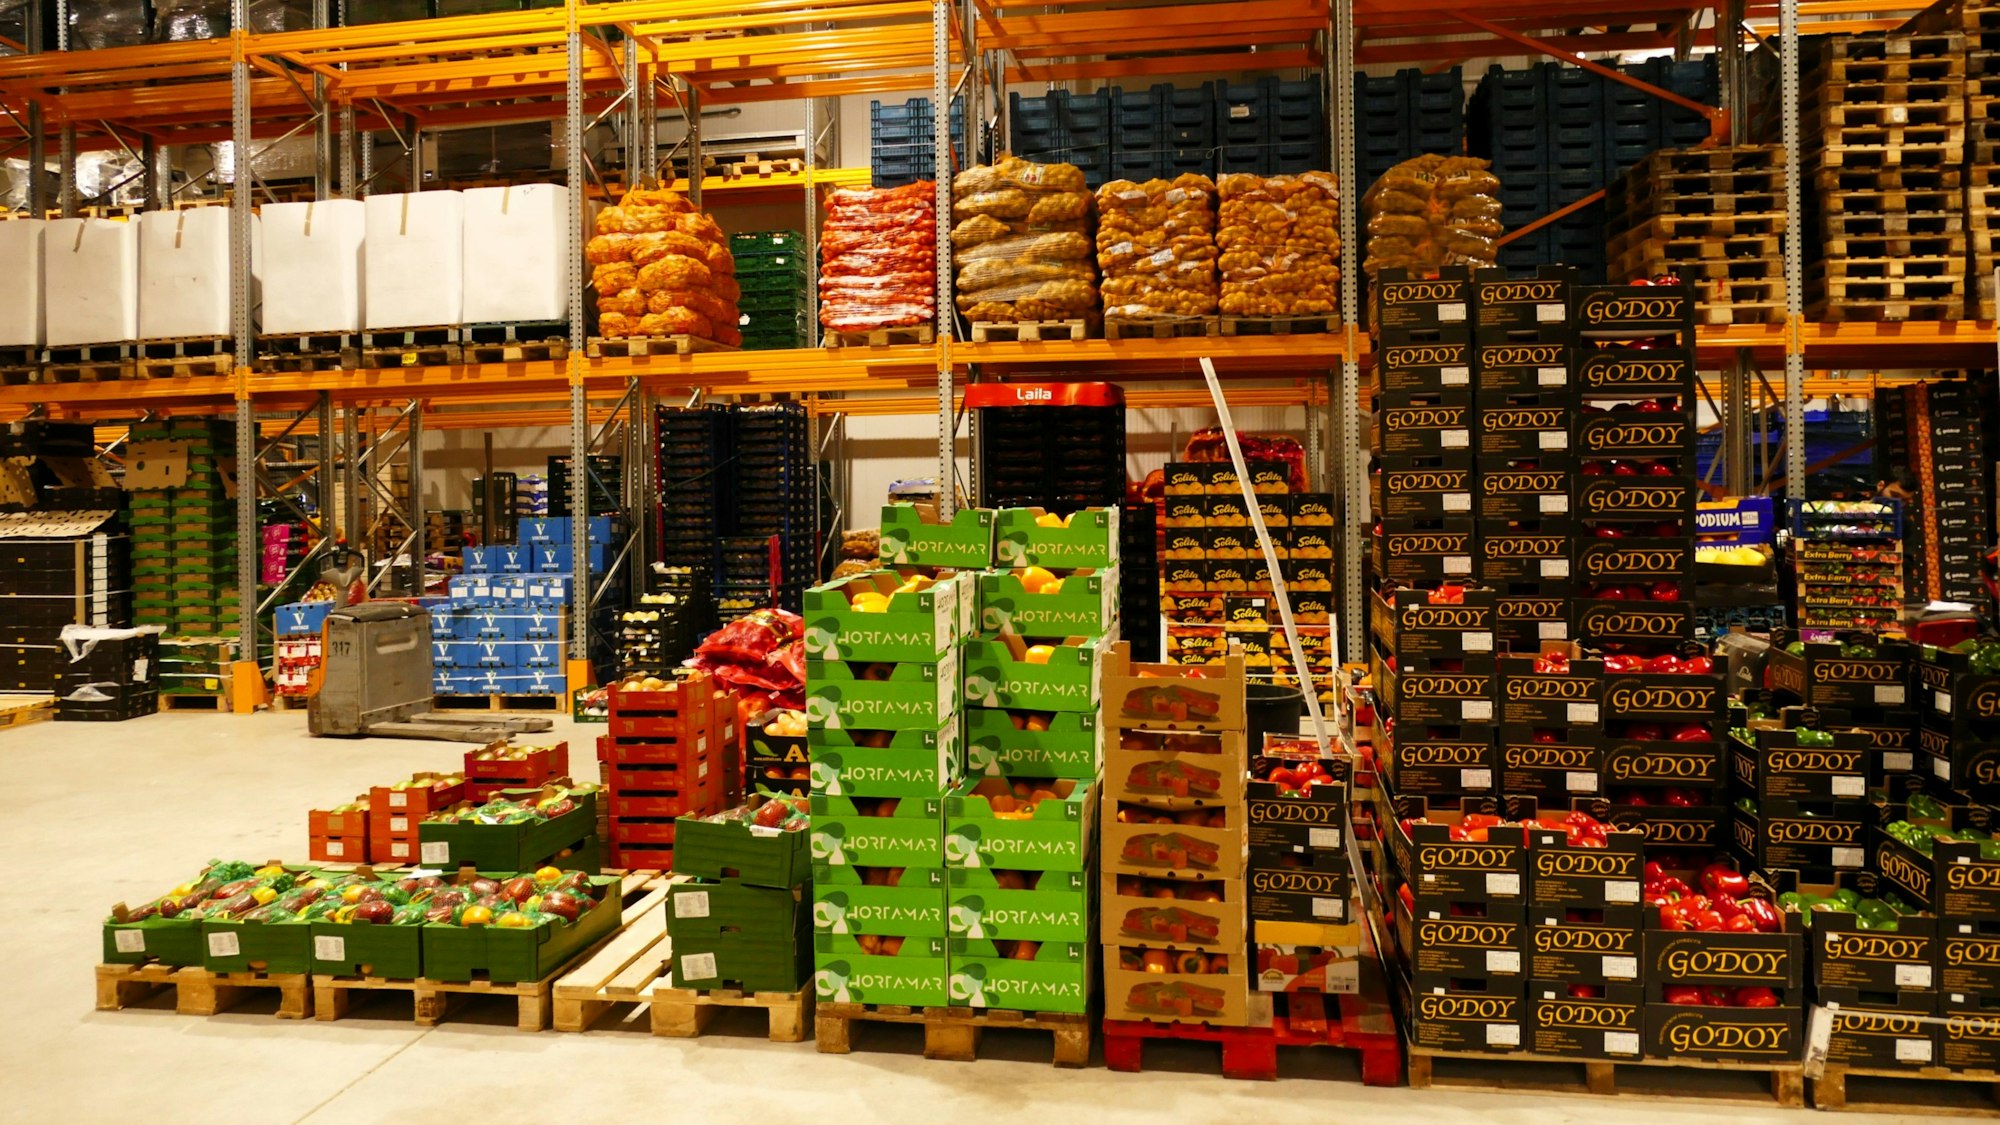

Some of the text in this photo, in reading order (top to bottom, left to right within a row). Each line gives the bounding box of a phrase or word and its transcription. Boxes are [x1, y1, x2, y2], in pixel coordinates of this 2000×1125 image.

[1384, 283, 1462, 305] GODOY
[1480, 283, 1560, 305] GODOY
[1588, 300, 1683, 323] GODOY
[1386, 347, 1464, 369] GODOY
[1482, 347, 1562, 369] GODOY
[1588, 364, 1684, 387] GODOY
[1017, 388, 1052, 400] Laila
[1386, 410, 1464, 431] GODOY
[1483, 410, 1563, 432] GODOY
[1588, 426, 1684, 450] GODOY
[1172, 472, 1198, 484] Solita
[1255, 472, 1282, 482] Solita
[1388, 473, 1466, 495] GODOY
[1484, 475, 1563, 496] GODOY
[1172, 505, 1199, 516] Solita
[1213, 504, 1239, 515] Solita
[1300, 503, 1327, 515] Solita
[1589, 489, 1685, 512] GODOY
[1696, 511, 1740, 527] ODIUM
[908, 540, 986, 555] HORTAMAR
[1026, 542, 1106, 557] HORTAMAR
[1173, 537, 1199, 549] Solita
[1214, 537, 1240, 548] Solita
[1298, 536, 1325, 548] Solita
[1389, 536, 1466, 557] GODOY
[1485, 538, 1565, 560] GODOY
[1588, 552, 1683, 575] GODOY
[1828, 552, 1852, 561] Berry
[1172, 569, 1198, 581] Solita
[1214, 569, 1240, 580] Solita
[1298, 569, 1325, 581] Solita
[1804, 573, 1851, 583] Extra Berry
[1179, 598, 1209, 610] Solita
[1298, 601, 1326, 614] Solita
[1498, 602, 1563, 618] ODOY
[1806, 596, 1853, 606] Extra Berry
[1012, 610, 1098, 624] HORTAMAR
[1233, 608, 1261, 620] Solita
[1402, 609, 1488, 631] GODOY
[1829, 619, 1853, 628] Berry
[1588, 614, 1684, 638] GODOY
[838, 632, 931, 646] HORTAMAR
[1181, 637, 1213, 649] Solita
[1182, 655, 1205, 665] Solita
[1814, 661, 1901, 683] GODOY
[998, 681, 1088, 698] HORTAMAR
[1402, 678, 1489, 699] GODOY
[1507, 679, 1594, 701] GODOY
[839, 700, 933, 716] HORTAMAR
[1612, 689, 1715, 713] GODOY
[1000, 748, 1090, 764] HORTAMAR
[1401, 746, 1488, 768] GODOY
[1506, 748, 1593, 769] GODOY
[1768, 751, 1863, 774] GODOY
[841, 767, 934, 783] HORTAMAR
[1612, 756, 1715, 780] GODOY
[1251, 804, 1336, 824] GODOY
[1768, 822, 1862, 844] GODOY
[844, 836, 937, 852] HORTAMAR
[980, 839, 1076, 855] HORTAMAR
[1420, 848, 1515, 870] GODOY
[1538, 854, 1634, 877] GODOY
[1254, 873, 1339, 894] GODOY
[1881, 852, 1930, 896] GODOY
[847, 906, 941, 922] HORTAMAR
[982, 910, 1079, 926] HORTAMAR
[1420, 924, 1515, 947] GODOY
[1536, 929, 1632, 952] GODOY
[1825, 936, 1928, 959] GODOY
[1668, 951, 1786, 979] GODOY
[849, 974, 942, 990] HORTAMAR
[984, 980, 1080, 997] HORTAMAR
[1421, 998, 1515, 1020] GODOY
[1538, 1004, 1634, 1028] GODOY
[1670, 1025, 1788, 1053] GODOY
